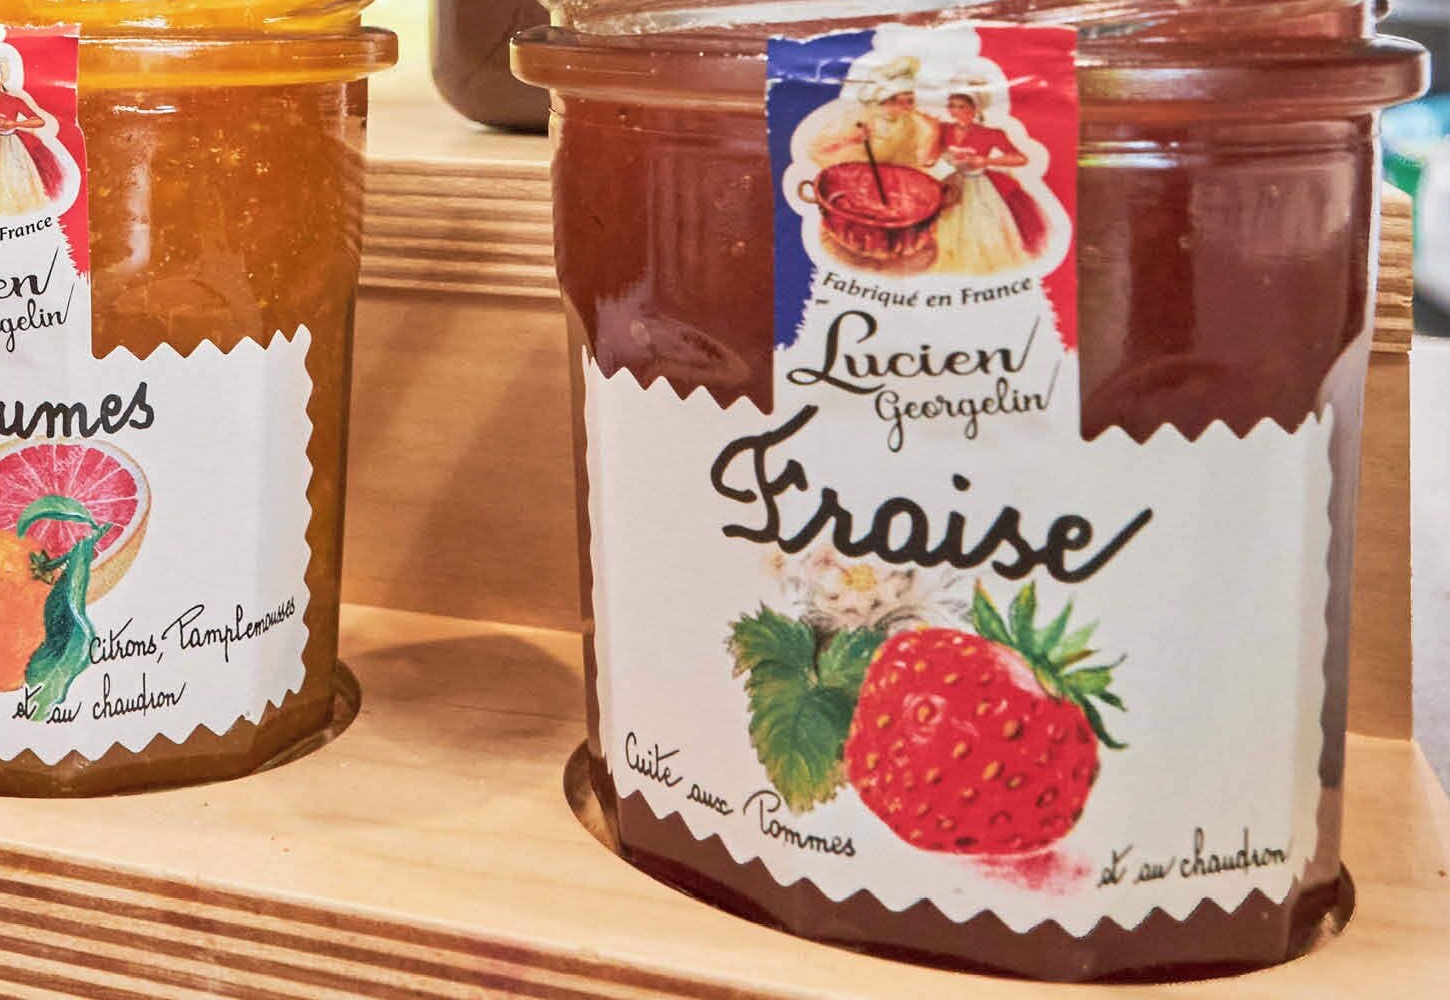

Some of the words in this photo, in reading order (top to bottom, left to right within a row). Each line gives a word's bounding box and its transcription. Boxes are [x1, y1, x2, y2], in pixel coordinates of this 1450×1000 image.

[0, 216, 53, 241] France
[822, 272, 917, 307] Fabriqué
[926, 292, 952, 307] en
[960, 276, 1033, 306] France
[786, 310, 1041, 395] Lucien
[874, 362, 1061, 453] Georgelin
[710, 404, 1153, 584] Fraise
[161, 596, 296, 663] Pamplemousses
[12, 685, 42, 719] et
[46, 701, 82, 724] au
[92, 672, 187, 720] chaudron
[625, 731, 683, 787] Cuite
[686, 784, 734, 816] aux
[743, 790, 856, 857] Pommes
[1097, 843, 1134, 888] et
[1134, 856, 1176, 884] au
[1180, 826, 1294, 876] chaudron
